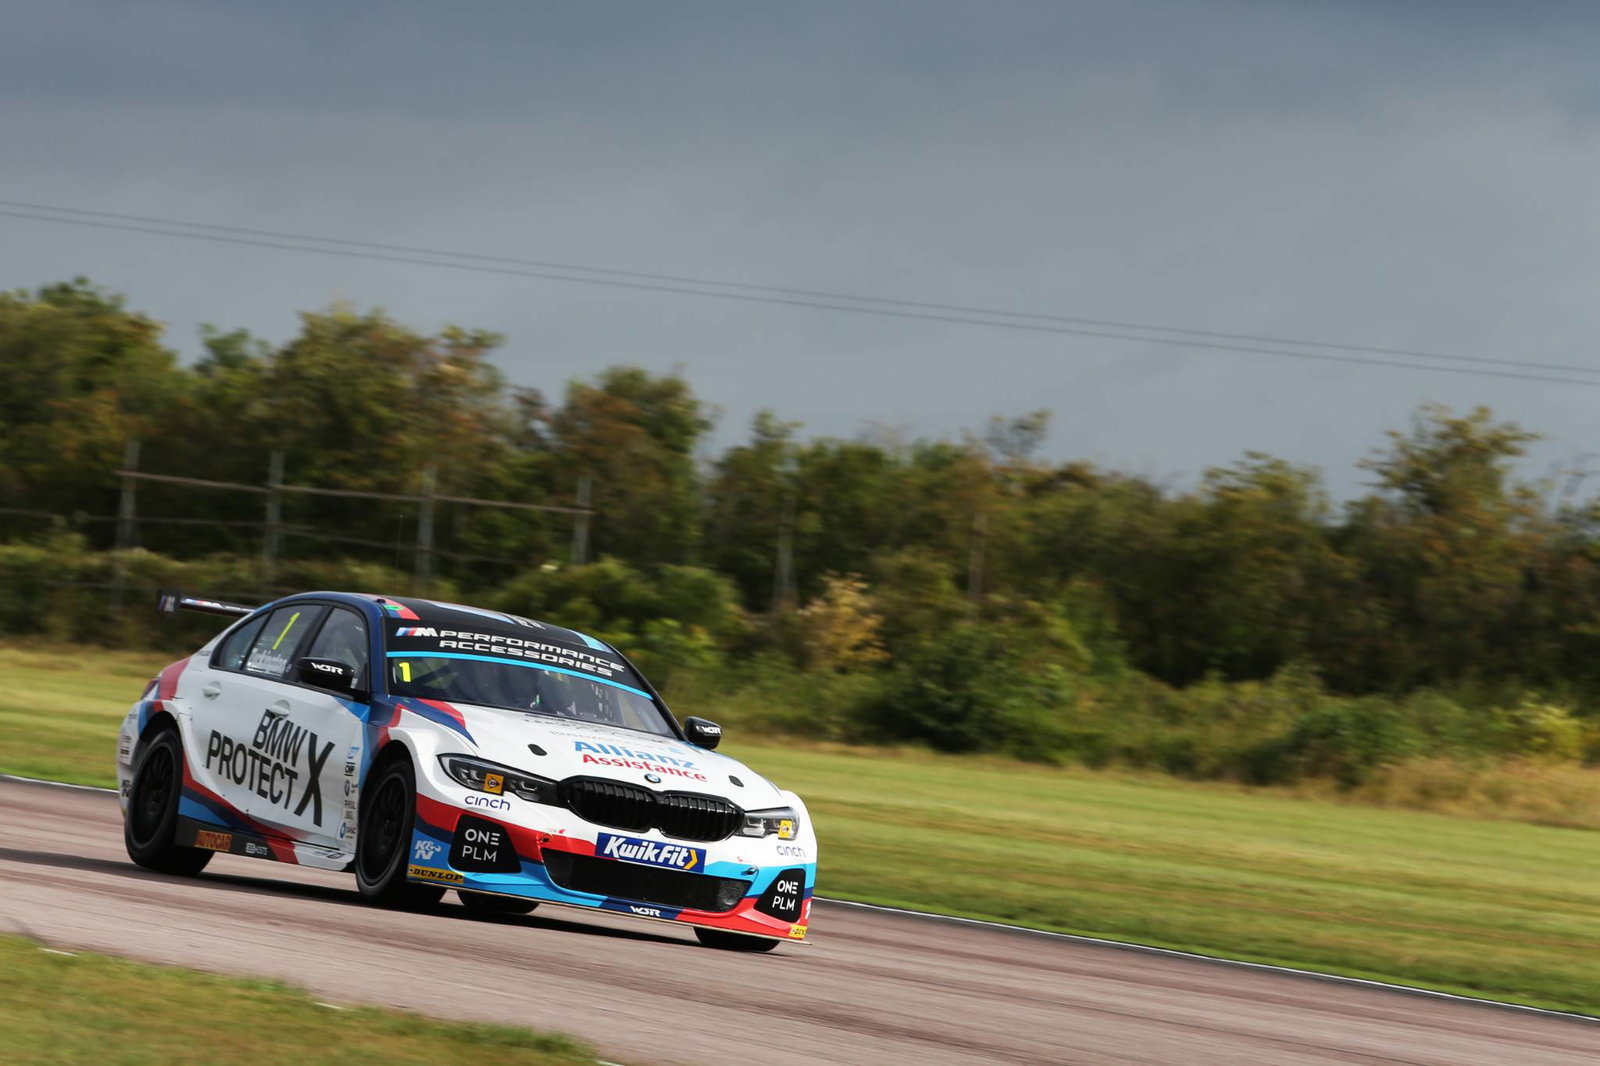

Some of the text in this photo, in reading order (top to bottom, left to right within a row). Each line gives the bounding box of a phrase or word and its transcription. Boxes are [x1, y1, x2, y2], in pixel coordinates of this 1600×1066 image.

[272, 612, 300, 650] 1
[440, 630, 624, 673] PERFORMANCE
[440, 640, 613, 677] ACCESSORIES
[399, 662, 411, 682] 1
[252, 708, 308, 768] BMW
[574, 741, 699, 770] Allianz
[206, 729, 299, 809] PROTECT
[583, 754, 708, 782] Assistance
[294, 732, 335, 827] X
[464, 795, 511, 811] cinch
[465, 828, 501, 846] ONE
[462, 845, 498, 863] PLM
[776, 845, 807, 858] cinch
[411, 868, 463, 882] DUNLOP
[777, 880, 799, 895] ONE
[630, 905, 661, 917] WSR
[772, 896, 796, 911] PLM
